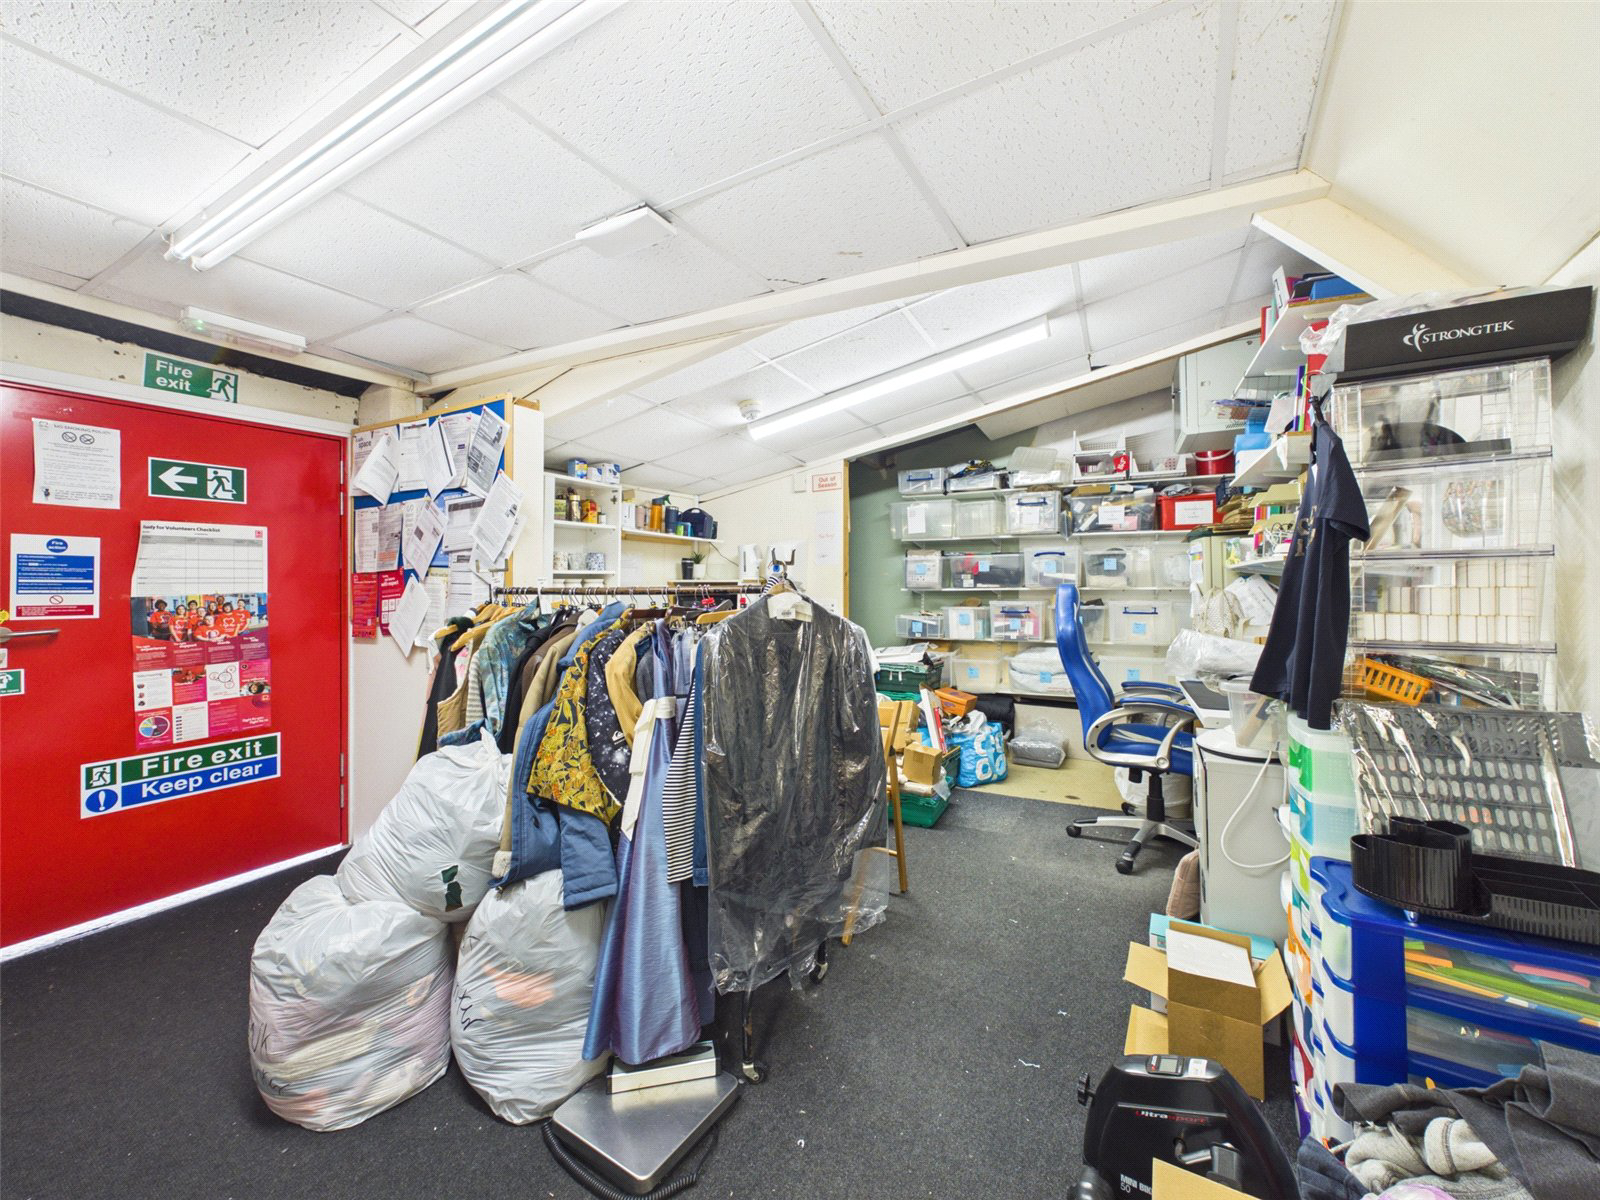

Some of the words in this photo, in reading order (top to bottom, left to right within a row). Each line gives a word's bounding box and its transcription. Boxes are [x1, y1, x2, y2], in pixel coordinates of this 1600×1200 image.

[1422, 320, 1515, 344] STRONGTEK
[155, 359, 193, 379] Fire
[155, 375, 191, 392] exit
[142, 754, 203, 777] Fire
[211, 740, 262, 764] exit
[141, 775, 203, 799] Keep
[209, 763, 263, 783] clear
[1120, 1173, 1138, 1189] MINI
[1120, 1182, 1131, 1193] 50
